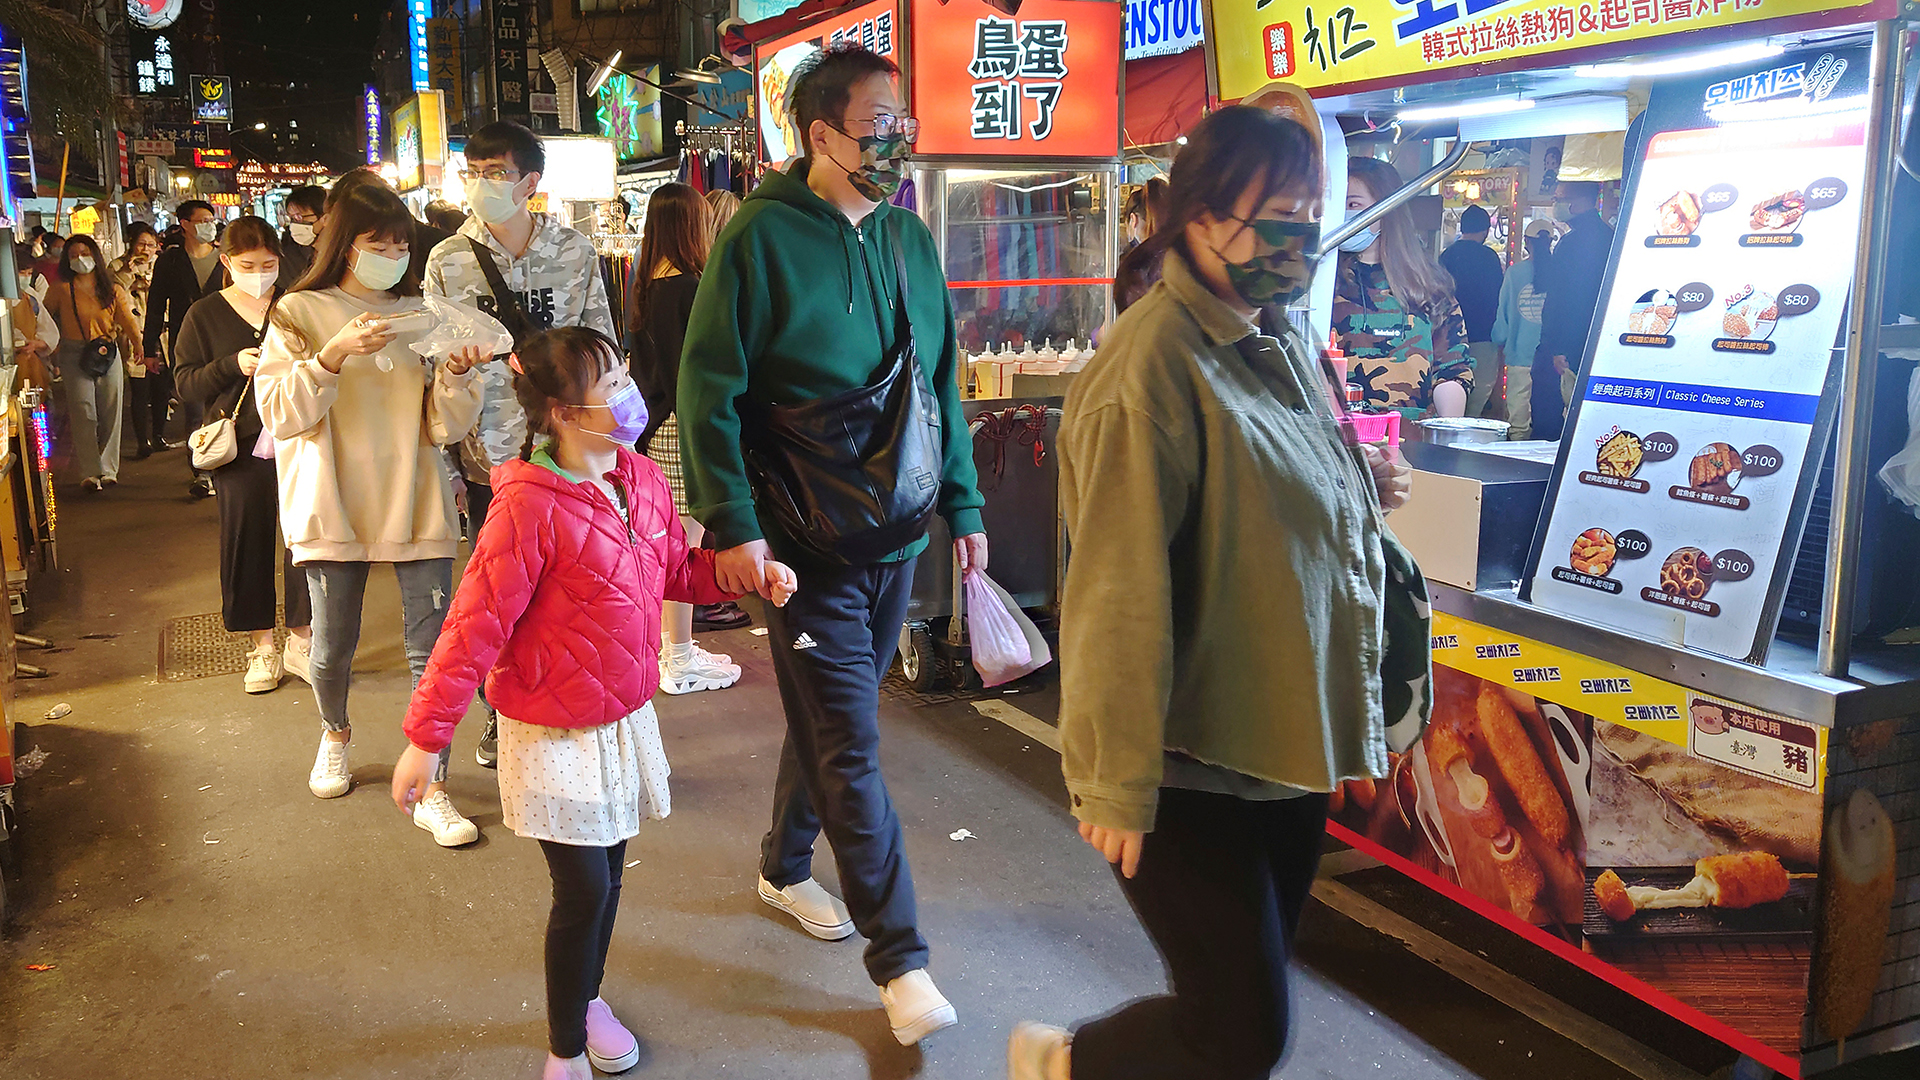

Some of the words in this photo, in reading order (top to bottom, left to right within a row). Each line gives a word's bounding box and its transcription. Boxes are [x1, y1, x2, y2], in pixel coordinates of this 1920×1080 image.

[1125, 0, 1202, 49] NSTOC
[498, 0, 521, 103] 品牙醫
[970, 18, 1066, 76] 鳥蛋
[1269, 27, 1289, 76] 樂樂
[154, 35, 175, 86] 永達利
[137, 60, 156, 93] 鐘錶
[1704, 63, 1805, 108] 오빠치즈
[972, 83, 1060, 137] 到了
[1706, 190, 1731, 203] $65
[1810, 186, 1837, 200] $65
[1681, 292, 1705, 303] $80
[1725, 283, 1753, 308] No.3
[1783, 293, 1809, 306] $80
[1592, 382, 1656, 400] 經典起司系列
[1665, 389, 1698, 402] Classic
[1701, 393, 1731, 406] Cheese
[1734, 396, 1765, 409] Series
[1595, 424, 1620, 448] No.2
[1643, 439, 1673, 454] $100
[1743, 453, 1777, 468] $100
[1617, 536, 1647, 552] $100
[1716, 557, 1749, 574] $100
[1475, 643, 1521, 659] 오빠치즈
[1513, 667, 1561, 682] 오빠치즈
[1580, 678, 1633, 694] 오빠치즈
[1624, 705, 1681, 721] 오빠치즈
[1729, 711, 1781, 736] 本店使用
[1730, 740, 1757, 761] 臺灣
[1782, 744, 1808, 774] 豬
